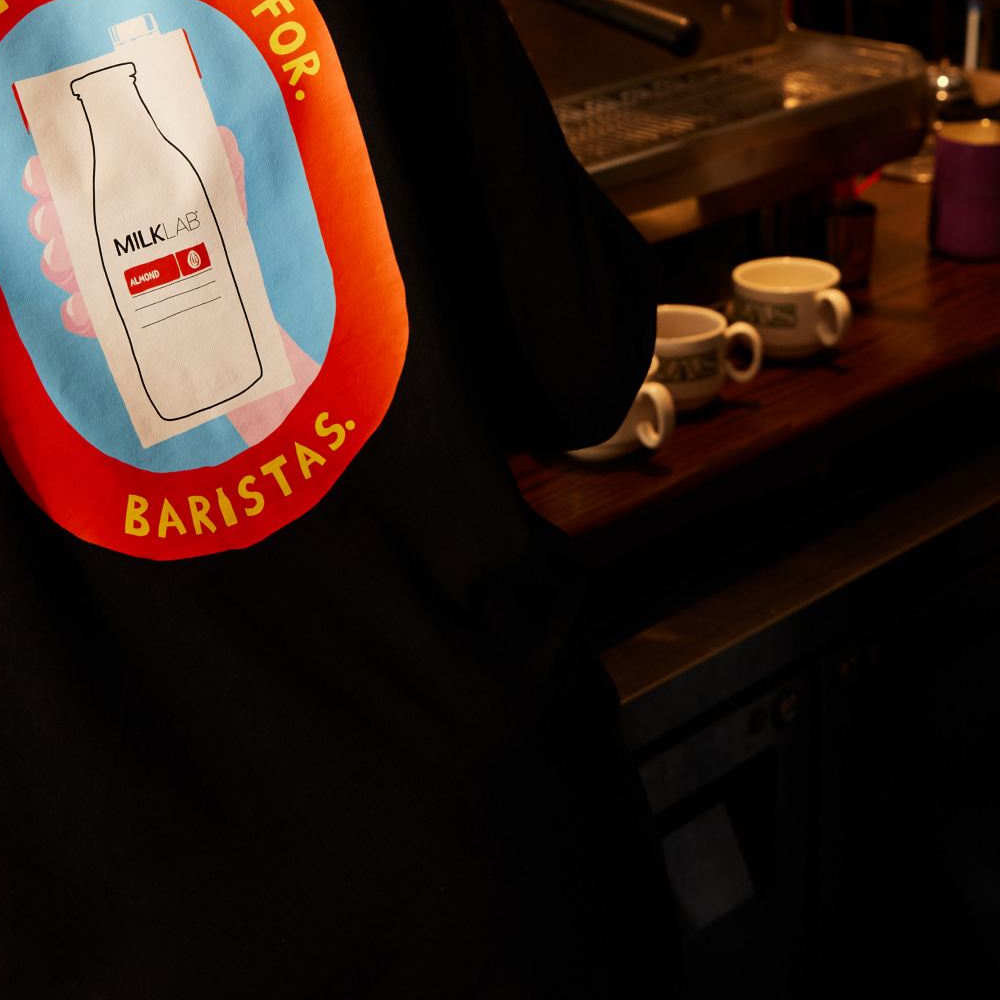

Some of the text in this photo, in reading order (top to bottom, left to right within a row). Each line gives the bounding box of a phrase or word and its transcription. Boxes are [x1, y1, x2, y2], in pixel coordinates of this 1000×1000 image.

[113, 211, 201, 257] MILKLAB
[130, 269, 161, 288] ALMOND
[124, 411, 356, 539] BARISTAS.
